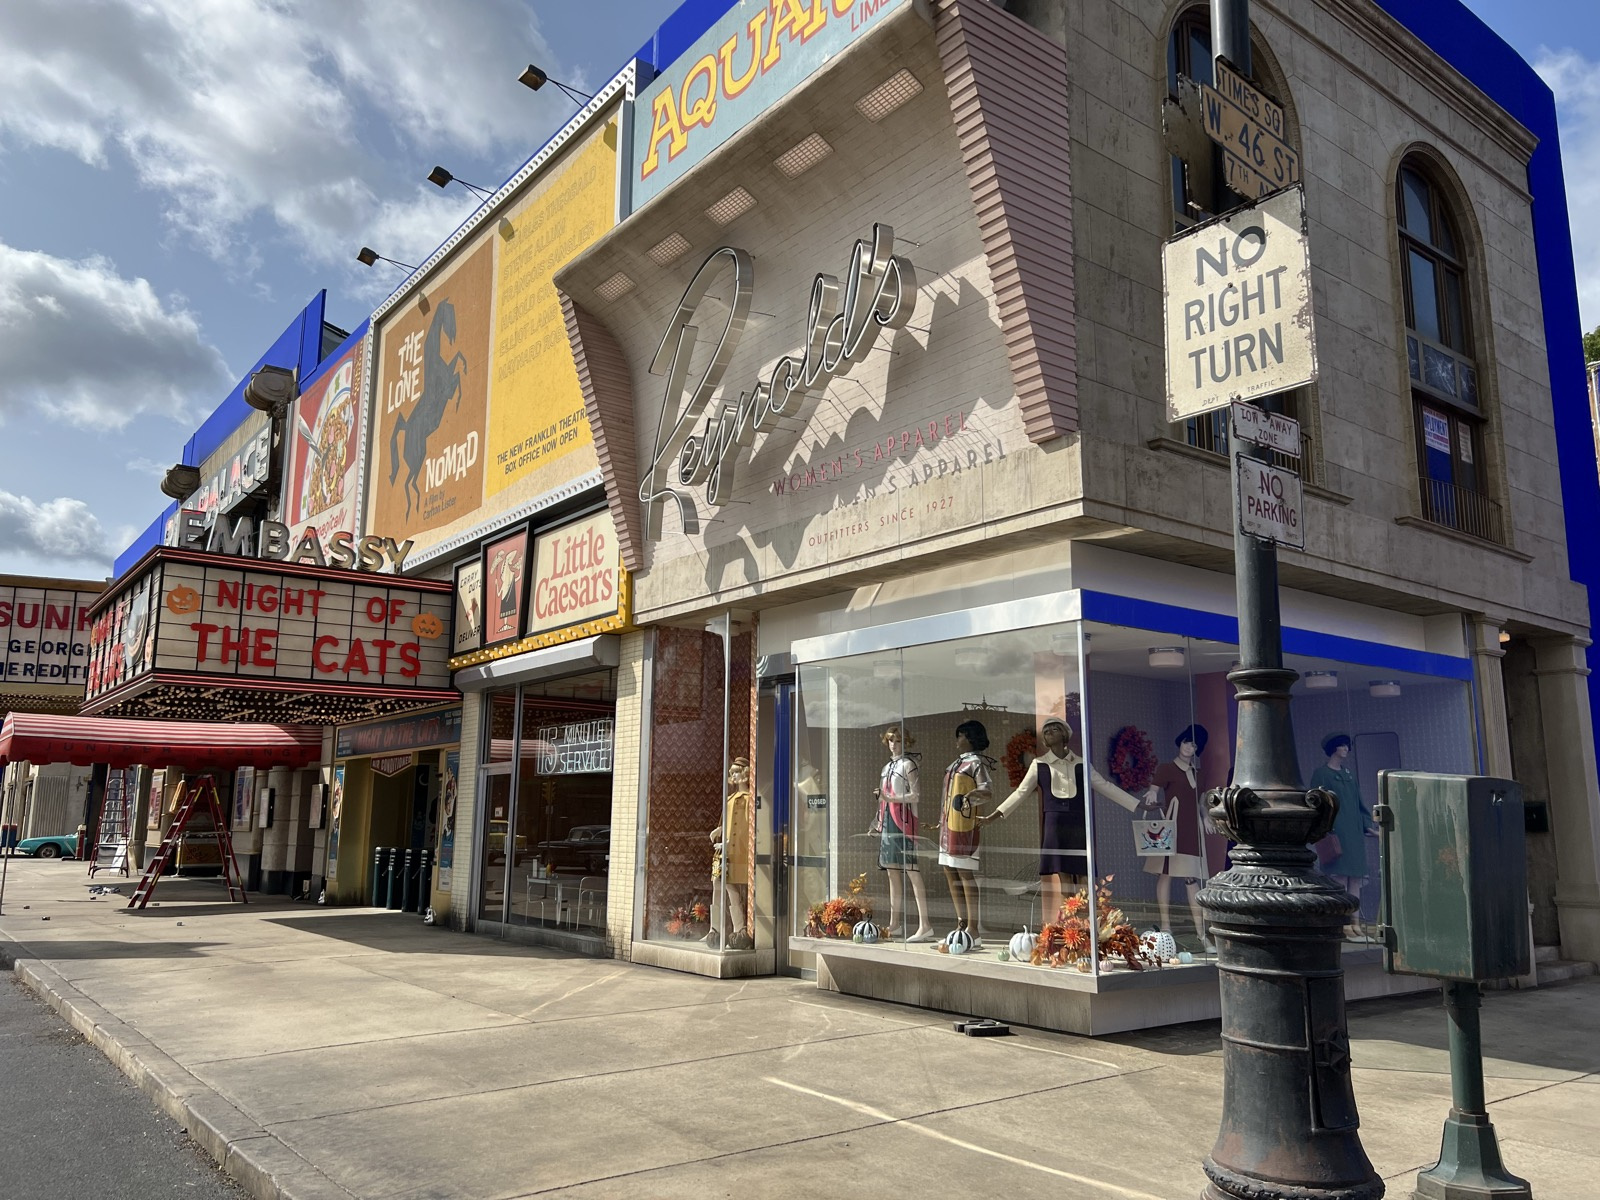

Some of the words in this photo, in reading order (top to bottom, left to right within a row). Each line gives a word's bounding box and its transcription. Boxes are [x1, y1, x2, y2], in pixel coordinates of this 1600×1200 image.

[1219, 67, 1260, 118] TIMES
[1264, 102, 1281, 135] SQ
[1227, 156, 1249, 184] 7TH
[1238, 122, 1266, 167] 46
[1273, 146, 1295, 183] ST
[546, 165, 597, 221] THEOBALD
[1195, 225, 1268, 287] NO
[500, 293, 536, 332] HAROLD
[1184, 265, 1288, 341] RIGHT
[398, 329, 425, 377] THE
[498, 340, 542, 382] MAYNARD
[499, 321, 530, 358] ELLIOT
[1188, 322, 1285, 389] TURN
[387, 367, 421, 414] LONE
[639, 222, 918, 541] Reynold's
[1202, 396, 1219, 407] DEPT
[1247, 379, 1275, 392] TRAFFIC
[496, 450, 509, 466] THE
[509, 441, 524, 459] NEW
[524, 422, 557, 450] FRANKLIN
[1240, 407, 1259, 425] TOW
[1269, 417, 1293, 436] AWAY
[1258, 428, 1279, 445] ZONE
[425, 430, 479, 493] NOMAD
[504, 460, 517, 475] BOX
[518, 446, 541, 468] OFFICE
[541, 437, 557, 456] NOW
[559, 426, 578, 446] OPEN
[773, 448, 863, 497] WOMEN'S
[874, 411, 968, 461] APPAREL
[1259, 470, 1284, 500] NO
[808, 521, 869, 547] OUTFITTERS
[880, 507, 914, 526] SINCE
[926, 496, 954, 514] 1927
[1247, 495, 1297, 527] PARKING
[180, 507, 414, 574] EMBASSY
[550, 526, 605, 581] Little
[217, 579, 326, 616] NIGHT
[366, 596, 406, 624] OF
[459, 568, 479, 589] CARRY
[535, 567, 614, 620] Caesars
[0, 662, 88, 680] EREDIT
[190, 622, 279, 667] THE
[312, 634, 421, 678] CATS
[536, 726, 558, 775] 15
[563, 720, 605, 744] MINUTE
[560, 749, 608, 773] SERVICE
